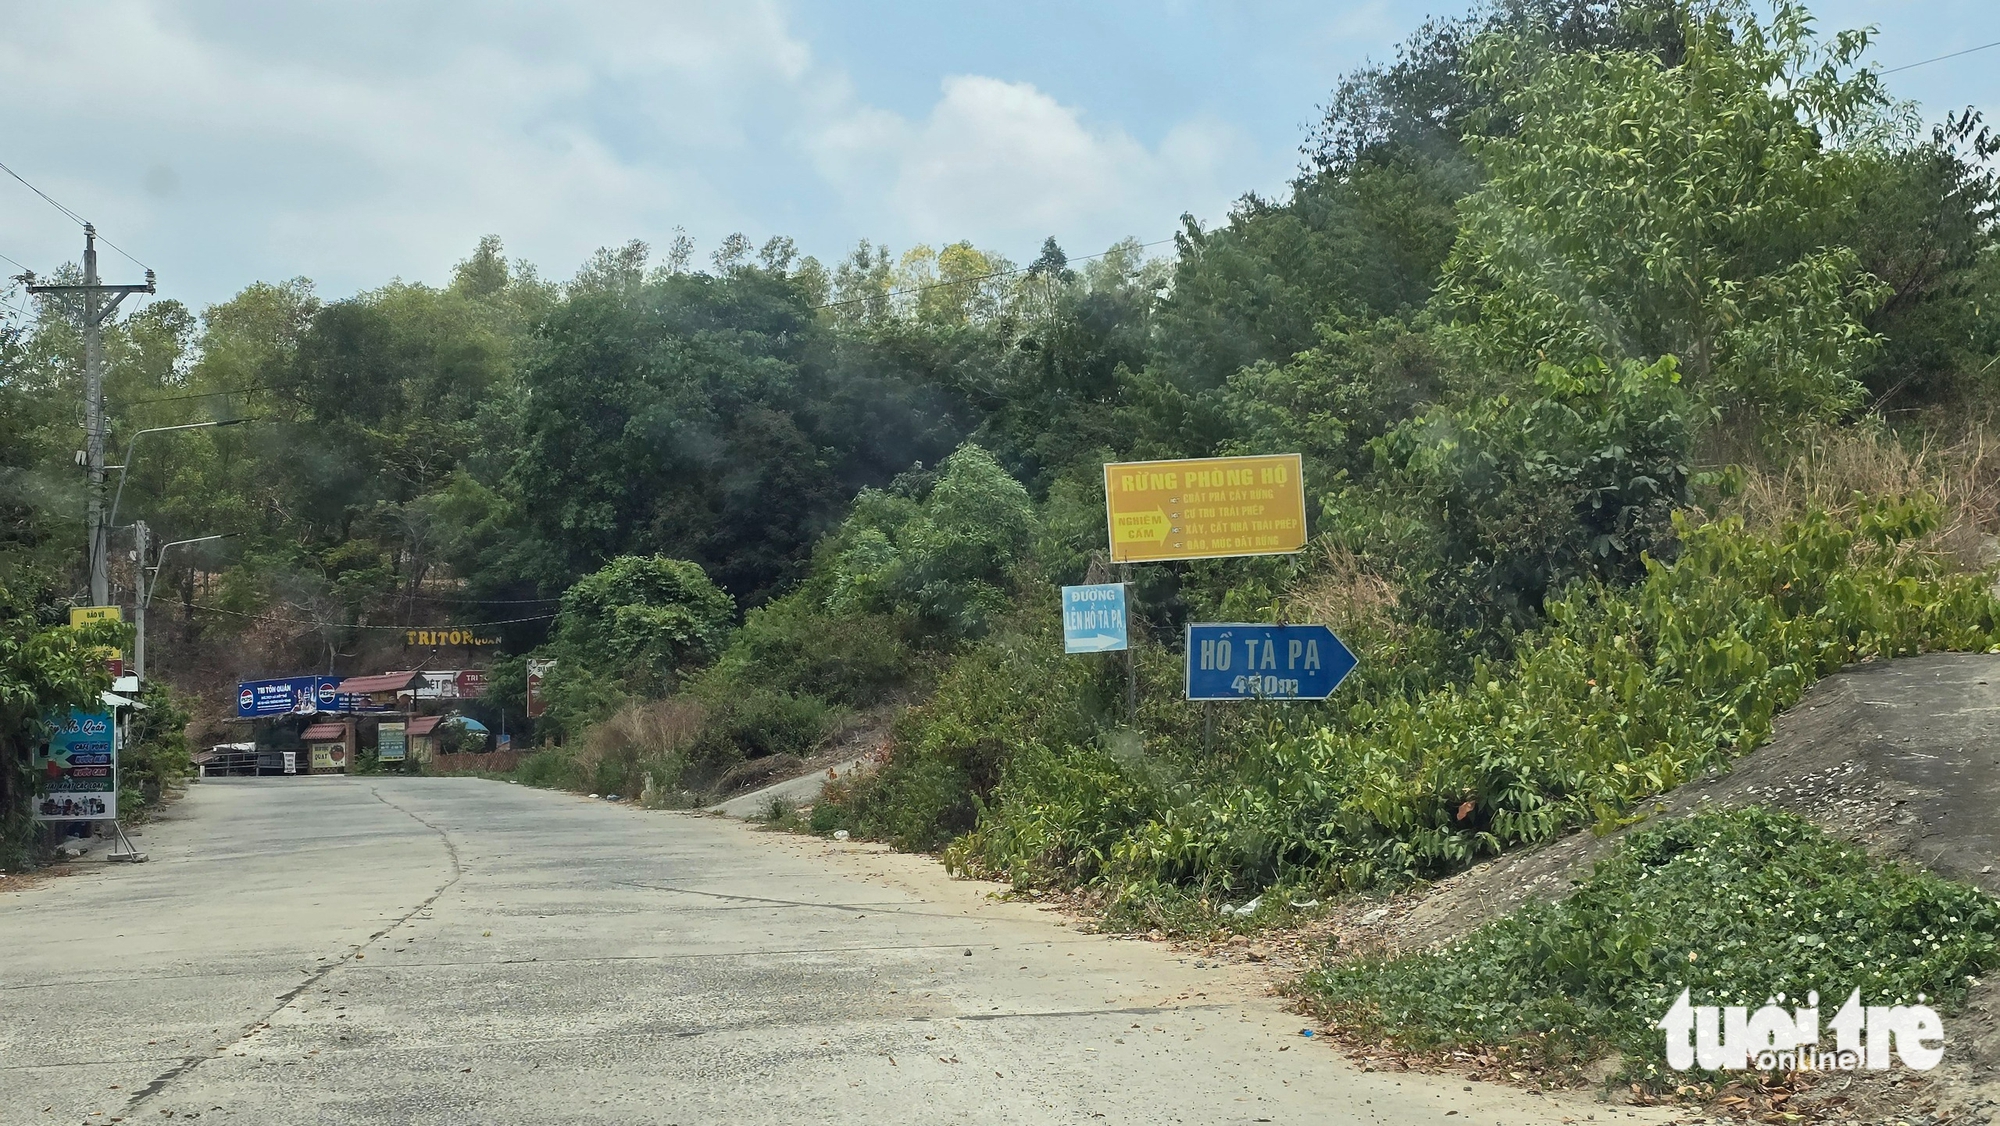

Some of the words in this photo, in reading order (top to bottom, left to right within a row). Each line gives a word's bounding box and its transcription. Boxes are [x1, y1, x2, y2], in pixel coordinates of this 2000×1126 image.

[1121, 471, 1178, 492] RỪNG
[1184, 467, 1254, 489] PHÒNG
[1260, 464, 1289, 488] HỘ
[1229, 489, 1248, 501] CÂY
[1250, 487, 1274, 500] RỪNG
[1219, 504, 1239, 517] TRÁI
[1241, 503, 1265, 516] PHÉP
[1118, 514, 1162, 526] NGHIÊM
[1210, 520, 1228, 533] CẤT
[1230, 520, 1249, 532] NHÀ
[1251, 519, 1273, 531] TRÁI
[1274, 517, 1298, 530] PHÉP
[1128, 526, 1154, 539] CẤM
[1234, 535, 1253, 548] ĐẤT
[1255, 534, 1279, 547] RỪNG
[1071, 588, 1115, 602] ĐƯỜNG
[1065, 609, 1083, 631] LÊN
[1083, 602, 1096, 630] HỒ
[1097, 605, 1109, 629] TÀ
[1110, 610, 1123, 631] PẠ
[1200, 629, 1232, 671] HỒ
[1245, 632, 1277, 670] TÀ
[1288, 639, 1321, 676] PẠ
[82, 719, 107, 736] Quán
